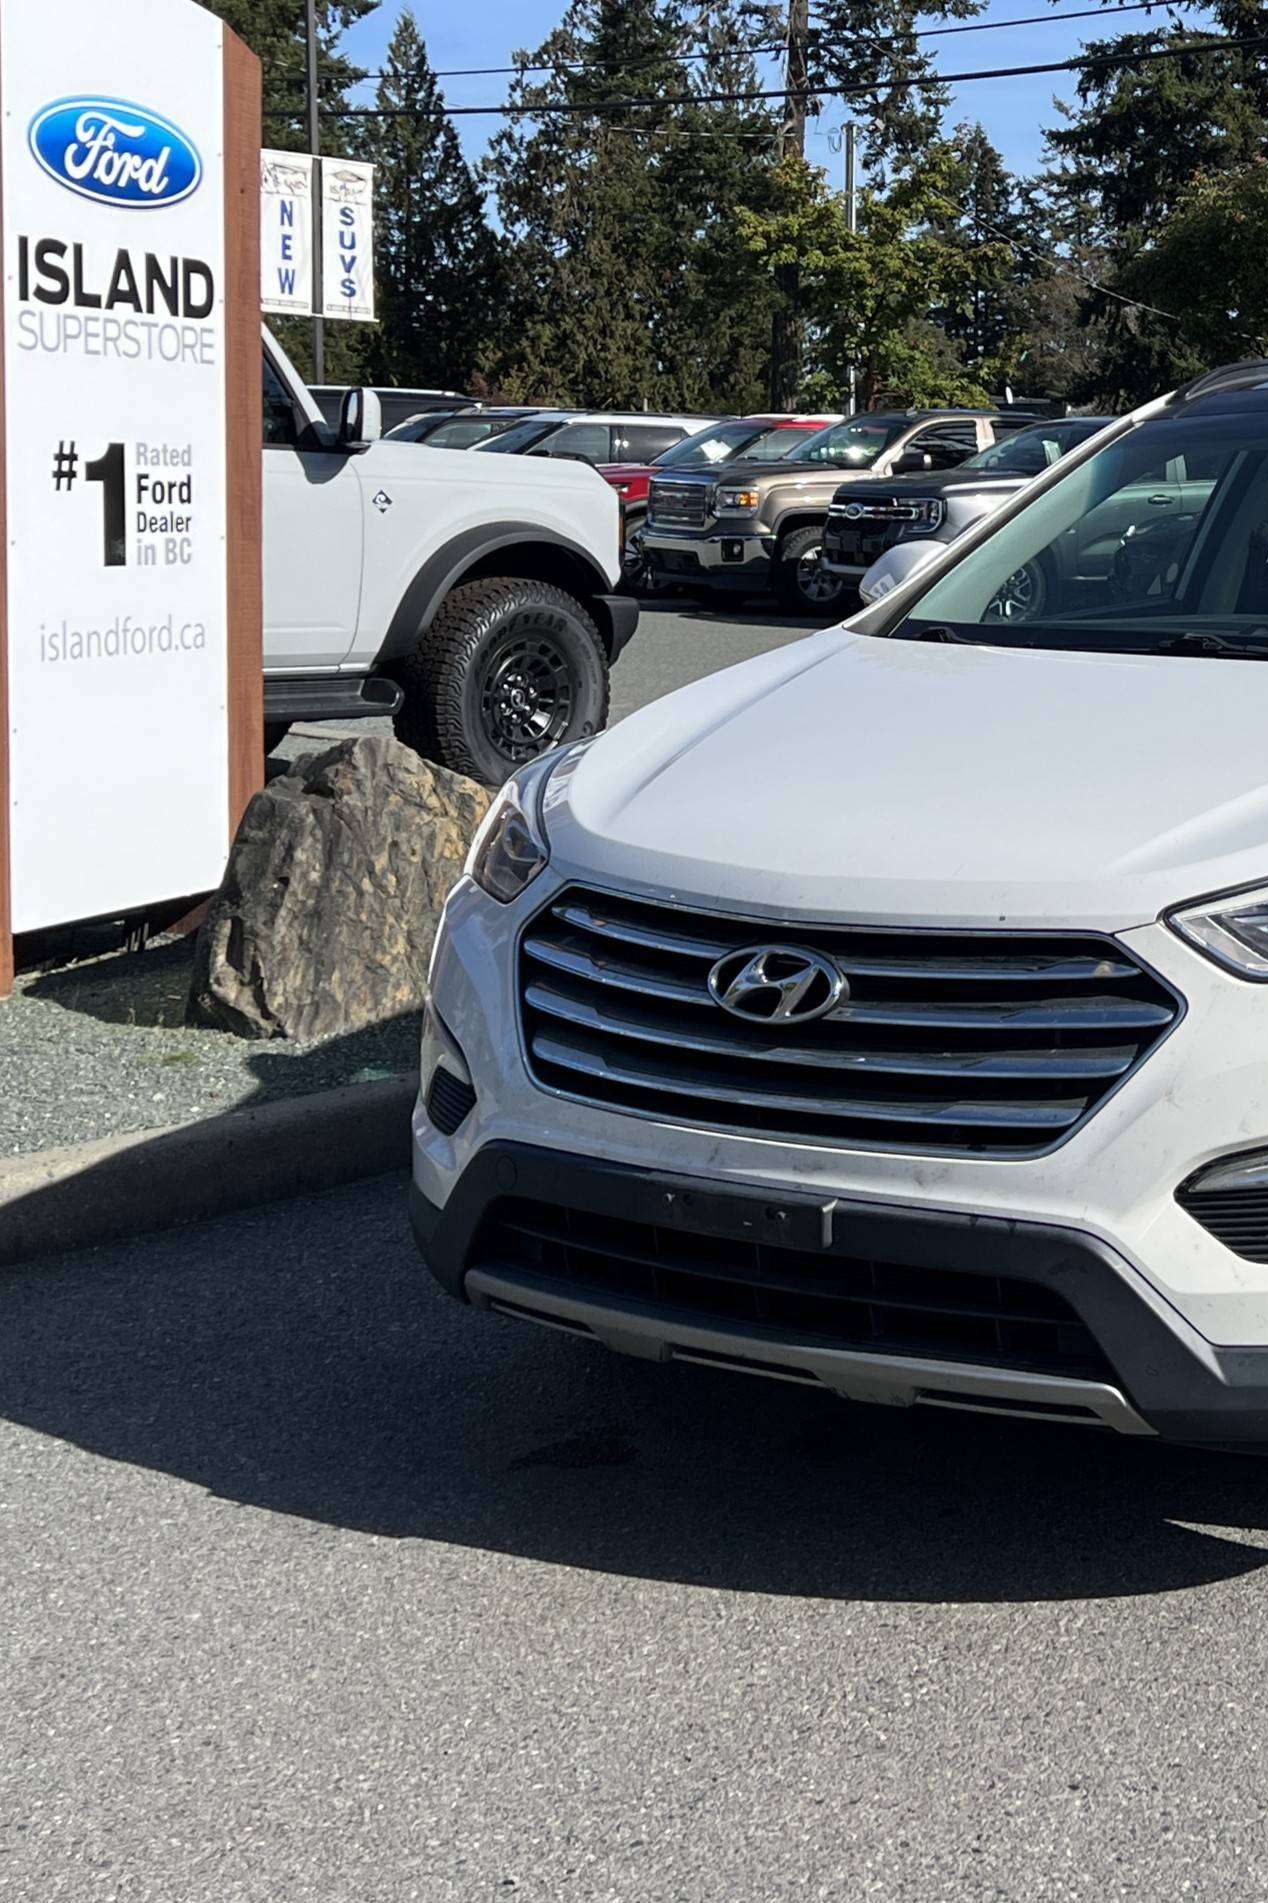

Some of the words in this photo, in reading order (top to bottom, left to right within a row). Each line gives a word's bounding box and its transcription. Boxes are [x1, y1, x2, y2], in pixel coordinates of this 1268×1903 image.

[64, 111, 171, 194] Ford
[278, 200, 295, 294] NEW
[18, 235, 214, 320] ISLAND
[17, 309, 215, 365] SUPERSTORE
[136, 442, 192, 467] Rated
[51, 440, 127, 567] #1
[136, 473, 192, 504] Ford
[136, 511, 192, 533] Dealer
[137, 538, 156, 566] in
[165, 537, 192, 565] BC
[40, 614, 206, 662] islandford.ca
